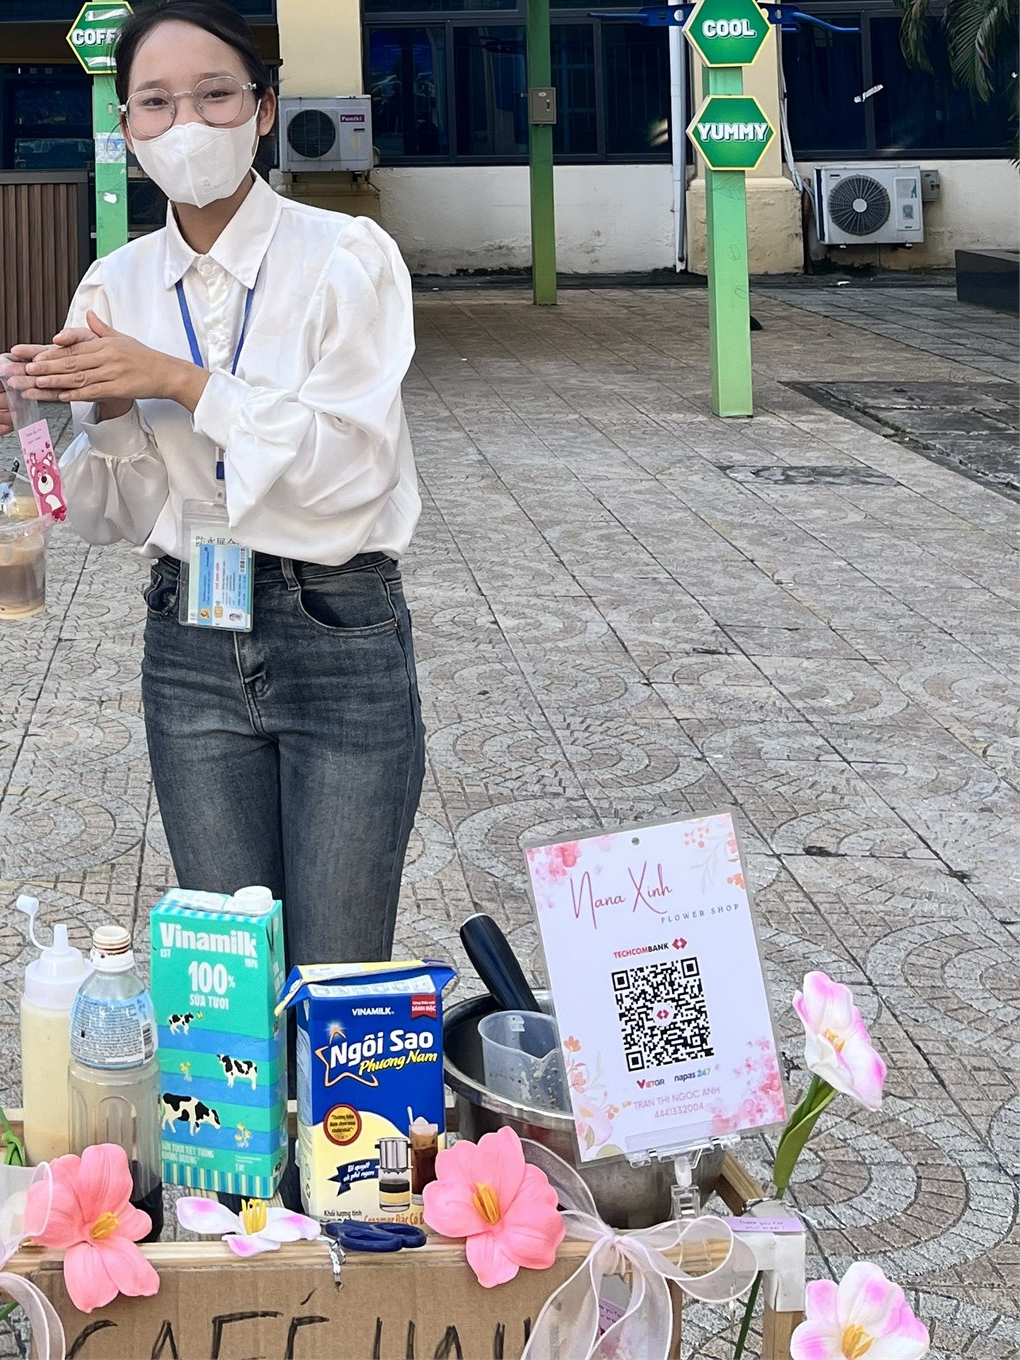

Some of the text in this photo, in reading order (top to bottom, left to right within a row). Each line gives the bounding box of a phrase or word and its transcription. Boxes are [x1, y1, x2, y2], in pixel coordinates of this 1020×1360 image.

[702, 19, 757, 38] COOL
[697, 122, 769, 142] YUMMY
[569, 861, 672, 929] Nana Xinh
[661, 903, 740, 924] FLOWER SHOP
[159, 922, 258, 958] Vinamilk
[160, 948, 171, 959] EST
[613, 942, 670, 959] TECHCOMBANK
[352, 1007, 391, 1016] VINAMILK
[330, 1030, 434, 1069] Ngôi Sao
[358, 1050, 438, 1076] Phương Nam
[674, 1071, 696, 1082] napas
[696, 1068, 711, 1078] 247
[633, 1098, 655, 1110] TRAN
[672, 1090, 700, 1101] NGOC
[701, 1086, 721, 1097] ANH
[654, 1103, 704, 1119] 4441332004
